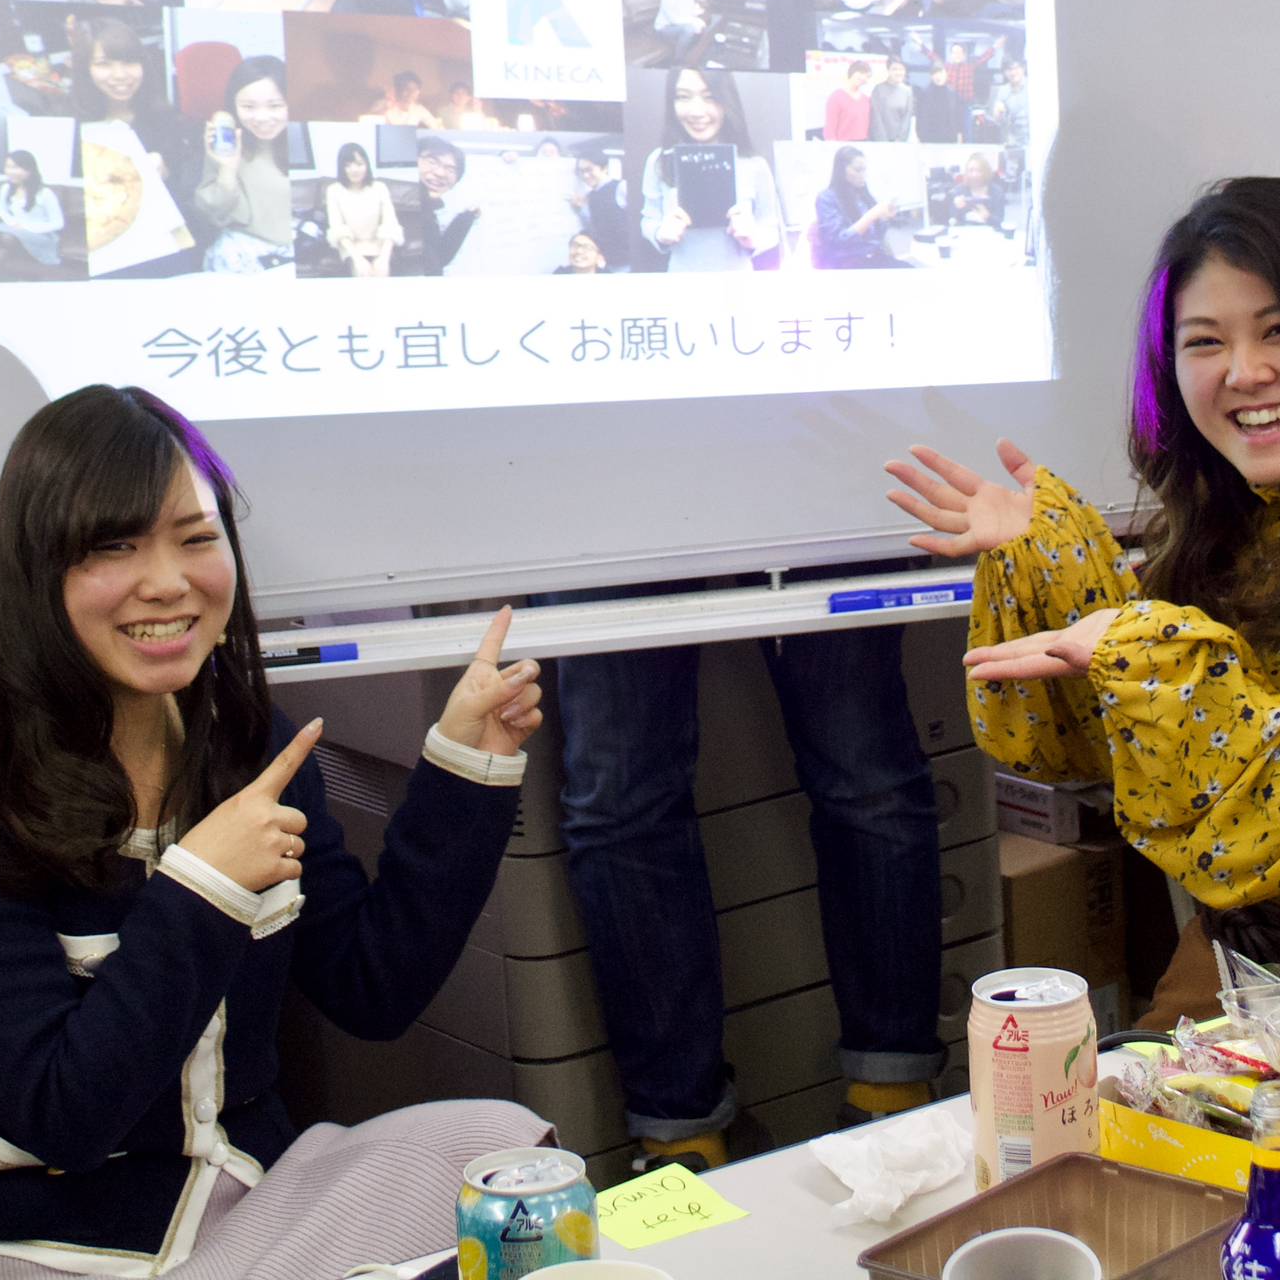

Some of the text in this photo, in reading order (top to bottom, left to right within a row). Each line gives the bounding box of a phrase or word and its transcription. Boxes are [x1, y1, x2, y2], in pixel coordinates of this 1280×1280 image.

[503, 61, 604, 84] KINECA
[141, 312, 899, 379] 今後とも宜しくお願いします！
[1006, 1029, 1030, 1043] アルミ
[1040, 1078, 1078, 1109] Now!
[1147, 1122, 1185, 1149] Glico
[516, 1217, 544, 1232] アルミ
